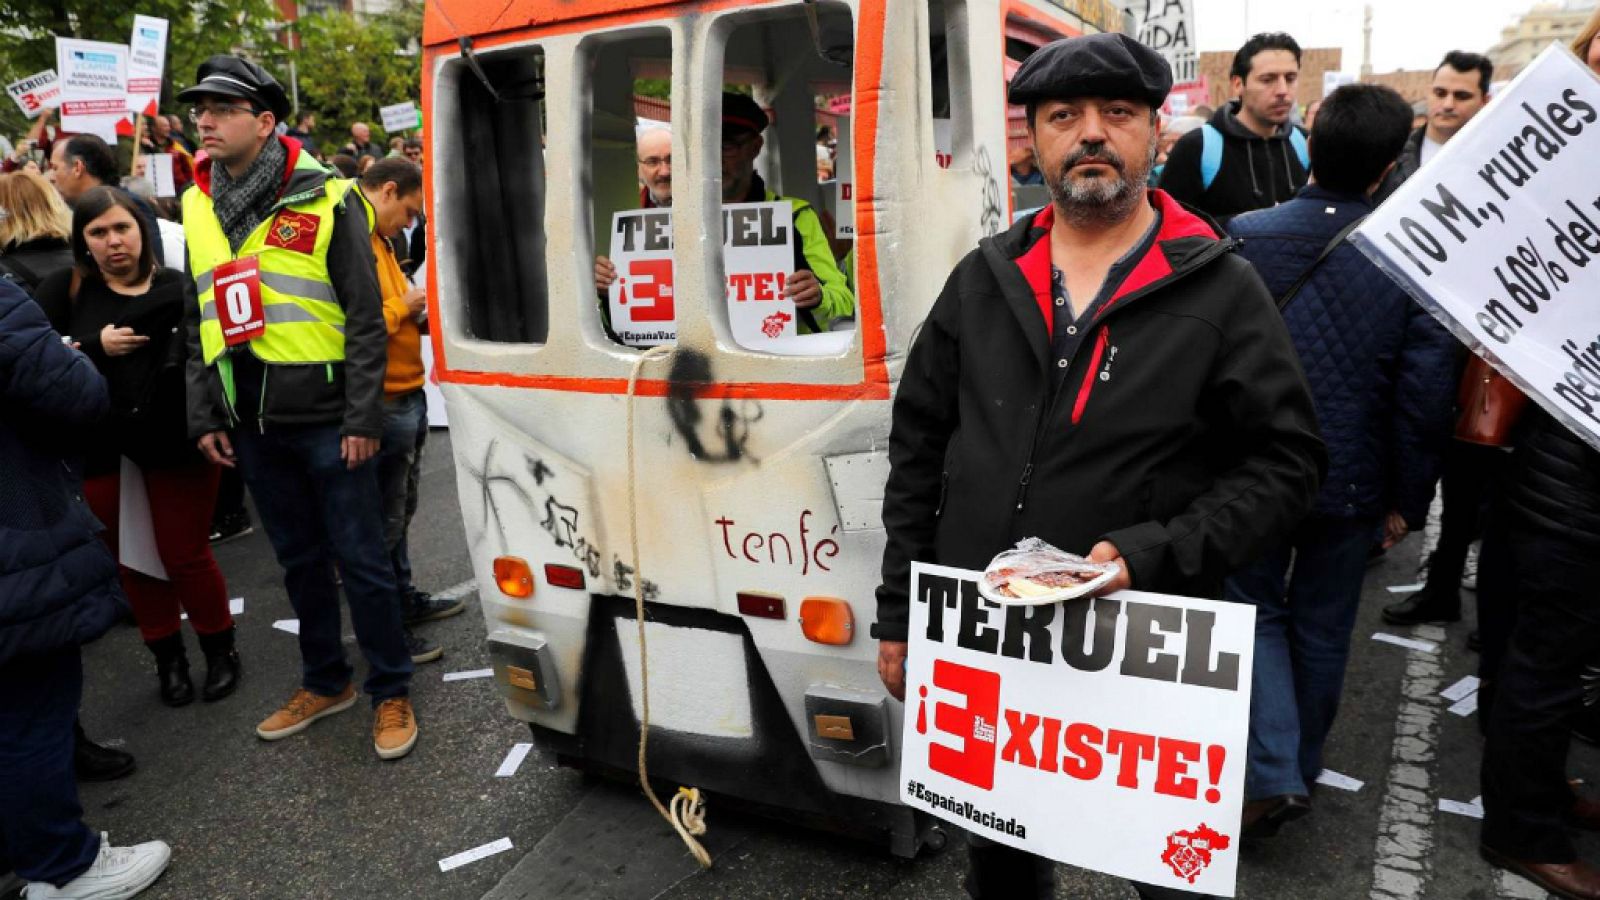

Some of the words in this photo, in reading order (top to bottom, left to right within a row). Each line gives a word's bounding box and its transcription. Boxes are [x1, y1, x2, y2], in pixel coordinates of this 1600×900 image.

[10, 71, 57, 95] TERUEL
[1478, 88, 1597, 201] rurales
[1546, 199, 1600, 267] del
[1494, 236, 1569, 314] 60%
[1475, 298, 1523, 344] en
[715, 509, 839, 576] tenfé
[918, 572, 1240, 691] TERUEL
[907, 780, 1026, 839] #EspañaVaciada
